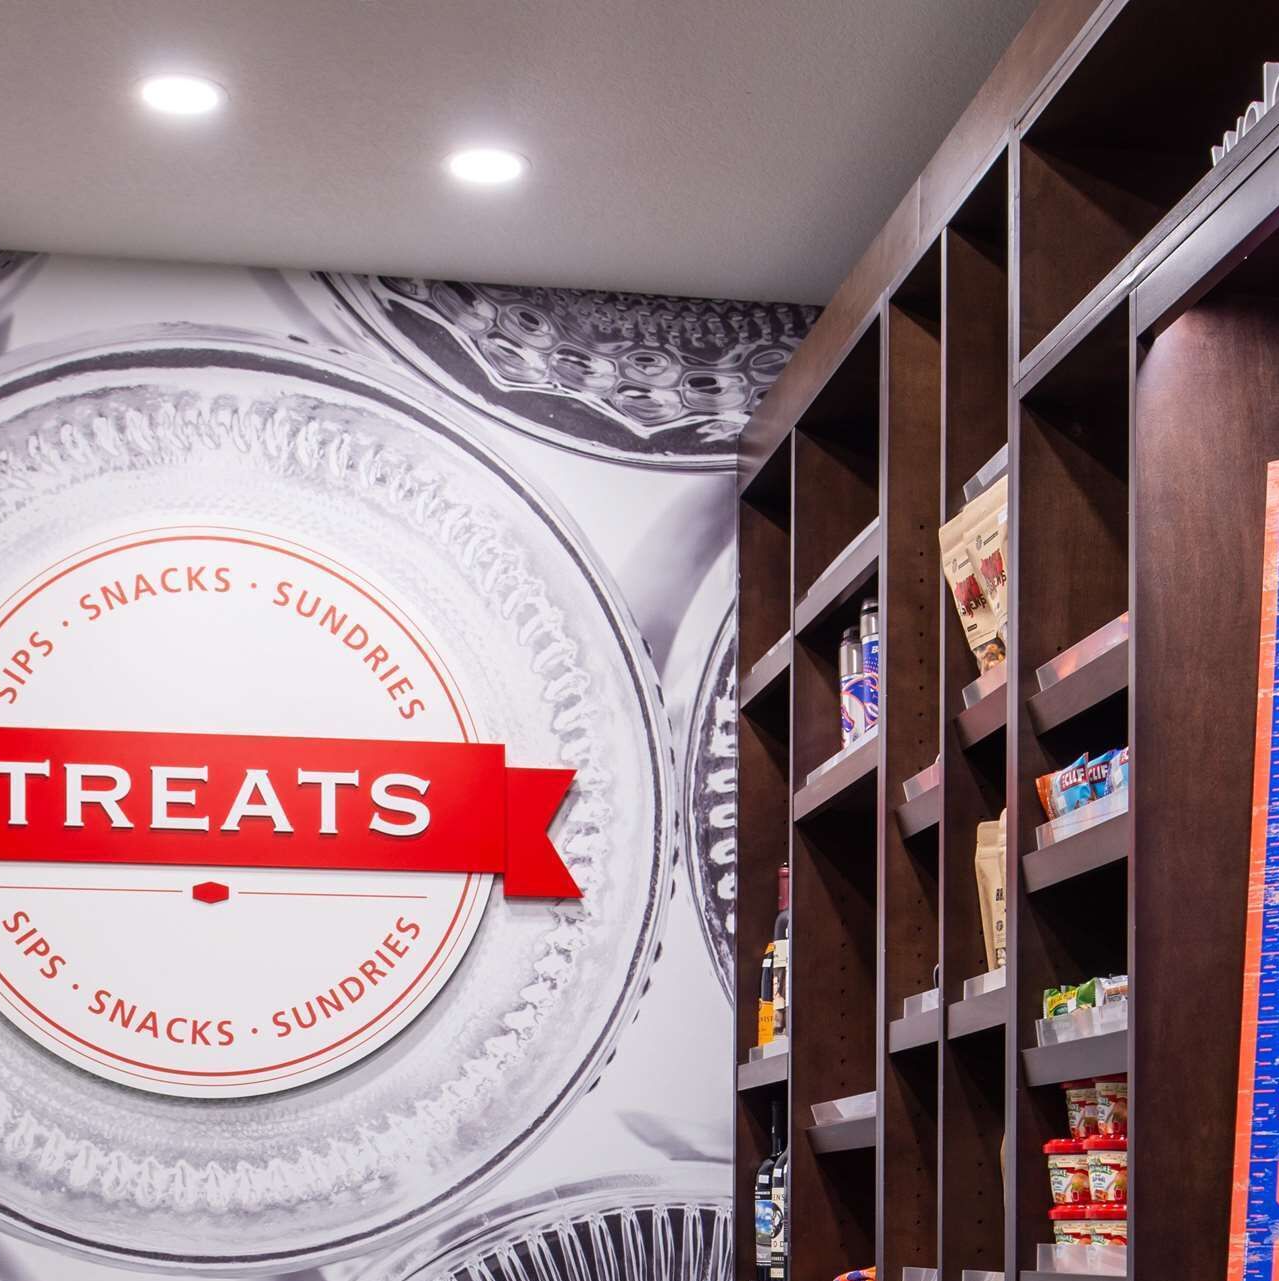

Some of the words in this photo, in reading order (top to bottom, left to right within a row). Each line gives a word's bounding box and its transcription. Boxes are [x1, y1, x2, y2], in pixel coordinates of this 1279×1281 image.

[79, 566, 232, 622] SNACKS
[272, 581, 426, 721] SUNDRIES
[1064, 767, 1085, 787] CLIF
[2, 910, 67, 981] SIPS
[87, 988, 236, 1048] SNACKS
[271, 916, 422, 1040] SUNDRIES
